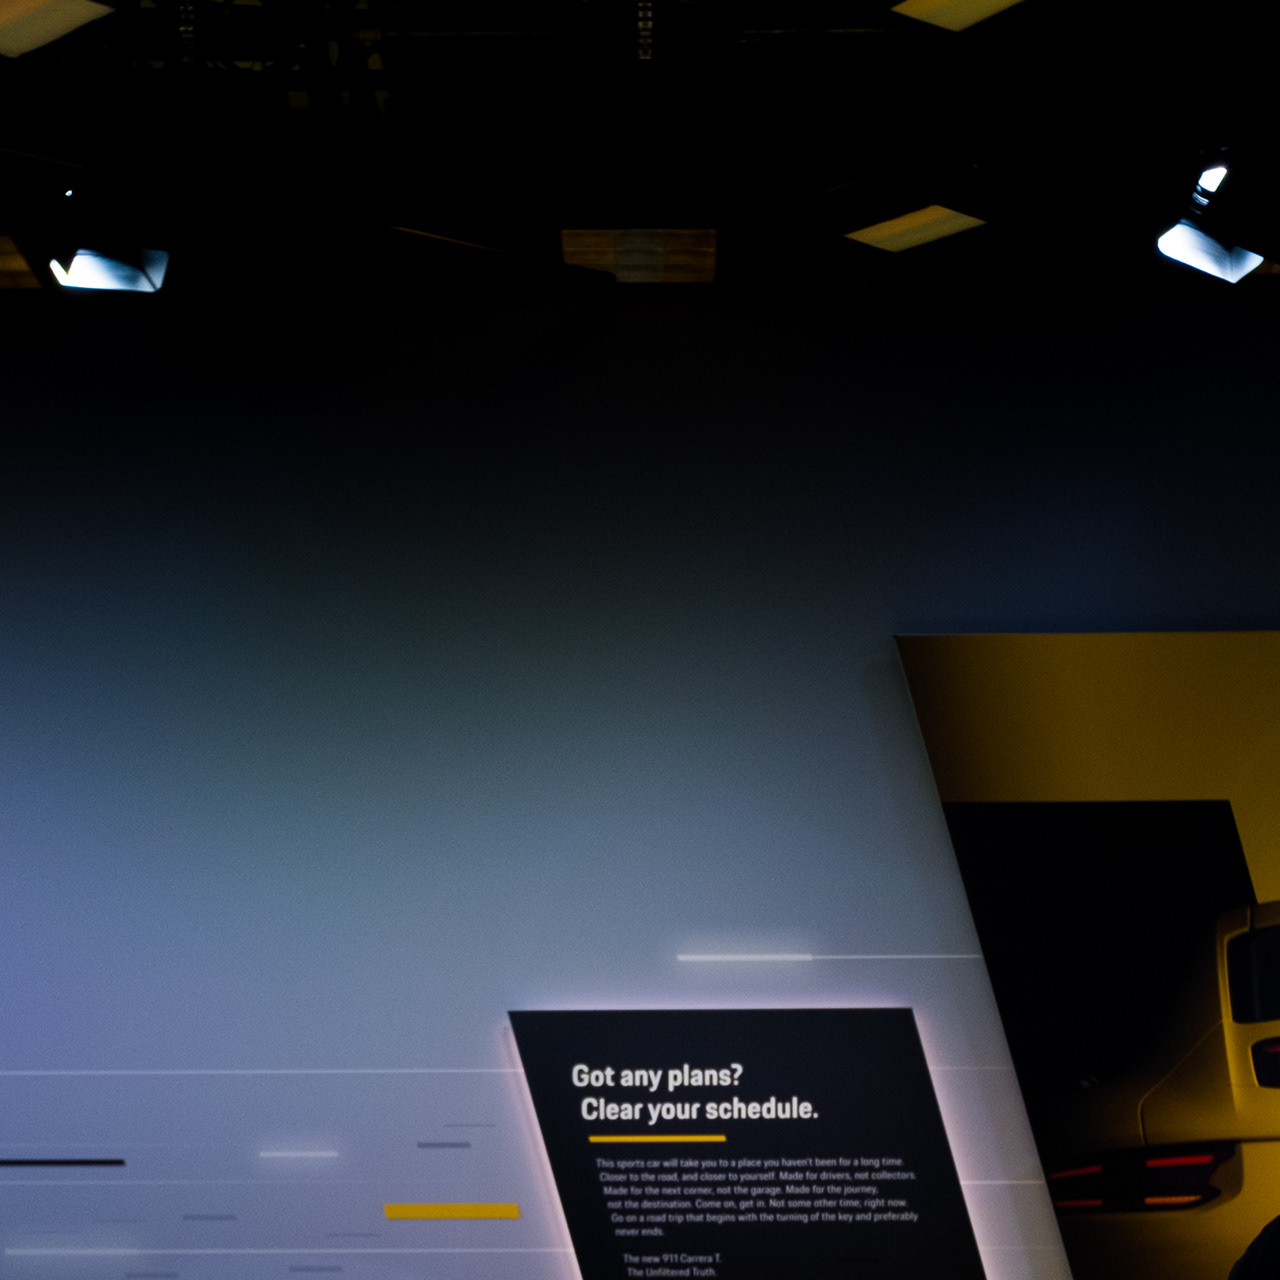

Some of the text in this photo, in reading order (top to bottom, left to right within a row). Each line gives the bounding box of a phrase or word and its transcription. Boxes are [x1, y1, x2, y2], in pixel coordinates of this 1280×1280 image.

[571, 1062, 744, 1092] Got any plans?
[580, 1096, 820, 1125] Clear your schedule.
[597, 1157, 904, 1170] This sports car will take you to a place you haven't been for a long time.
[600, 1170, 916, 1183] Closer to the road, and closer to yourself. Made for drivers, not collectors.
[604, 1184, 878, 1197] Made for the next corner, not the garage. Made for the journey,
[608, 1199, 623, 1210] not
[624, 1199, 640, 1209] the
[641, 1199, 694, 1209] destination.
[695, 1199, 722, 1209] Come
[723, 1201, 737, 1210] on,
[738, 1199, 754, 1210] get
[755, 1199, 767, 1208] in.
[768, 1198, 786, 1208] Not
[787, 1200, 812, 1208] some
[813, 1198, 837, 1208] other
[838, 1198, 862, 1208] time,
[863, 1198, 885, 1209] right
[611, 1211, 918, 1225] Go on a road trip that begins with the turning of the key and preferably
[615, 1226, 665, 1237] never ends.
[624, 1252, 722, 1264] The new 911 Carrera T.
[628, 1266, 718, 1277] The Unfiltered Truth.
